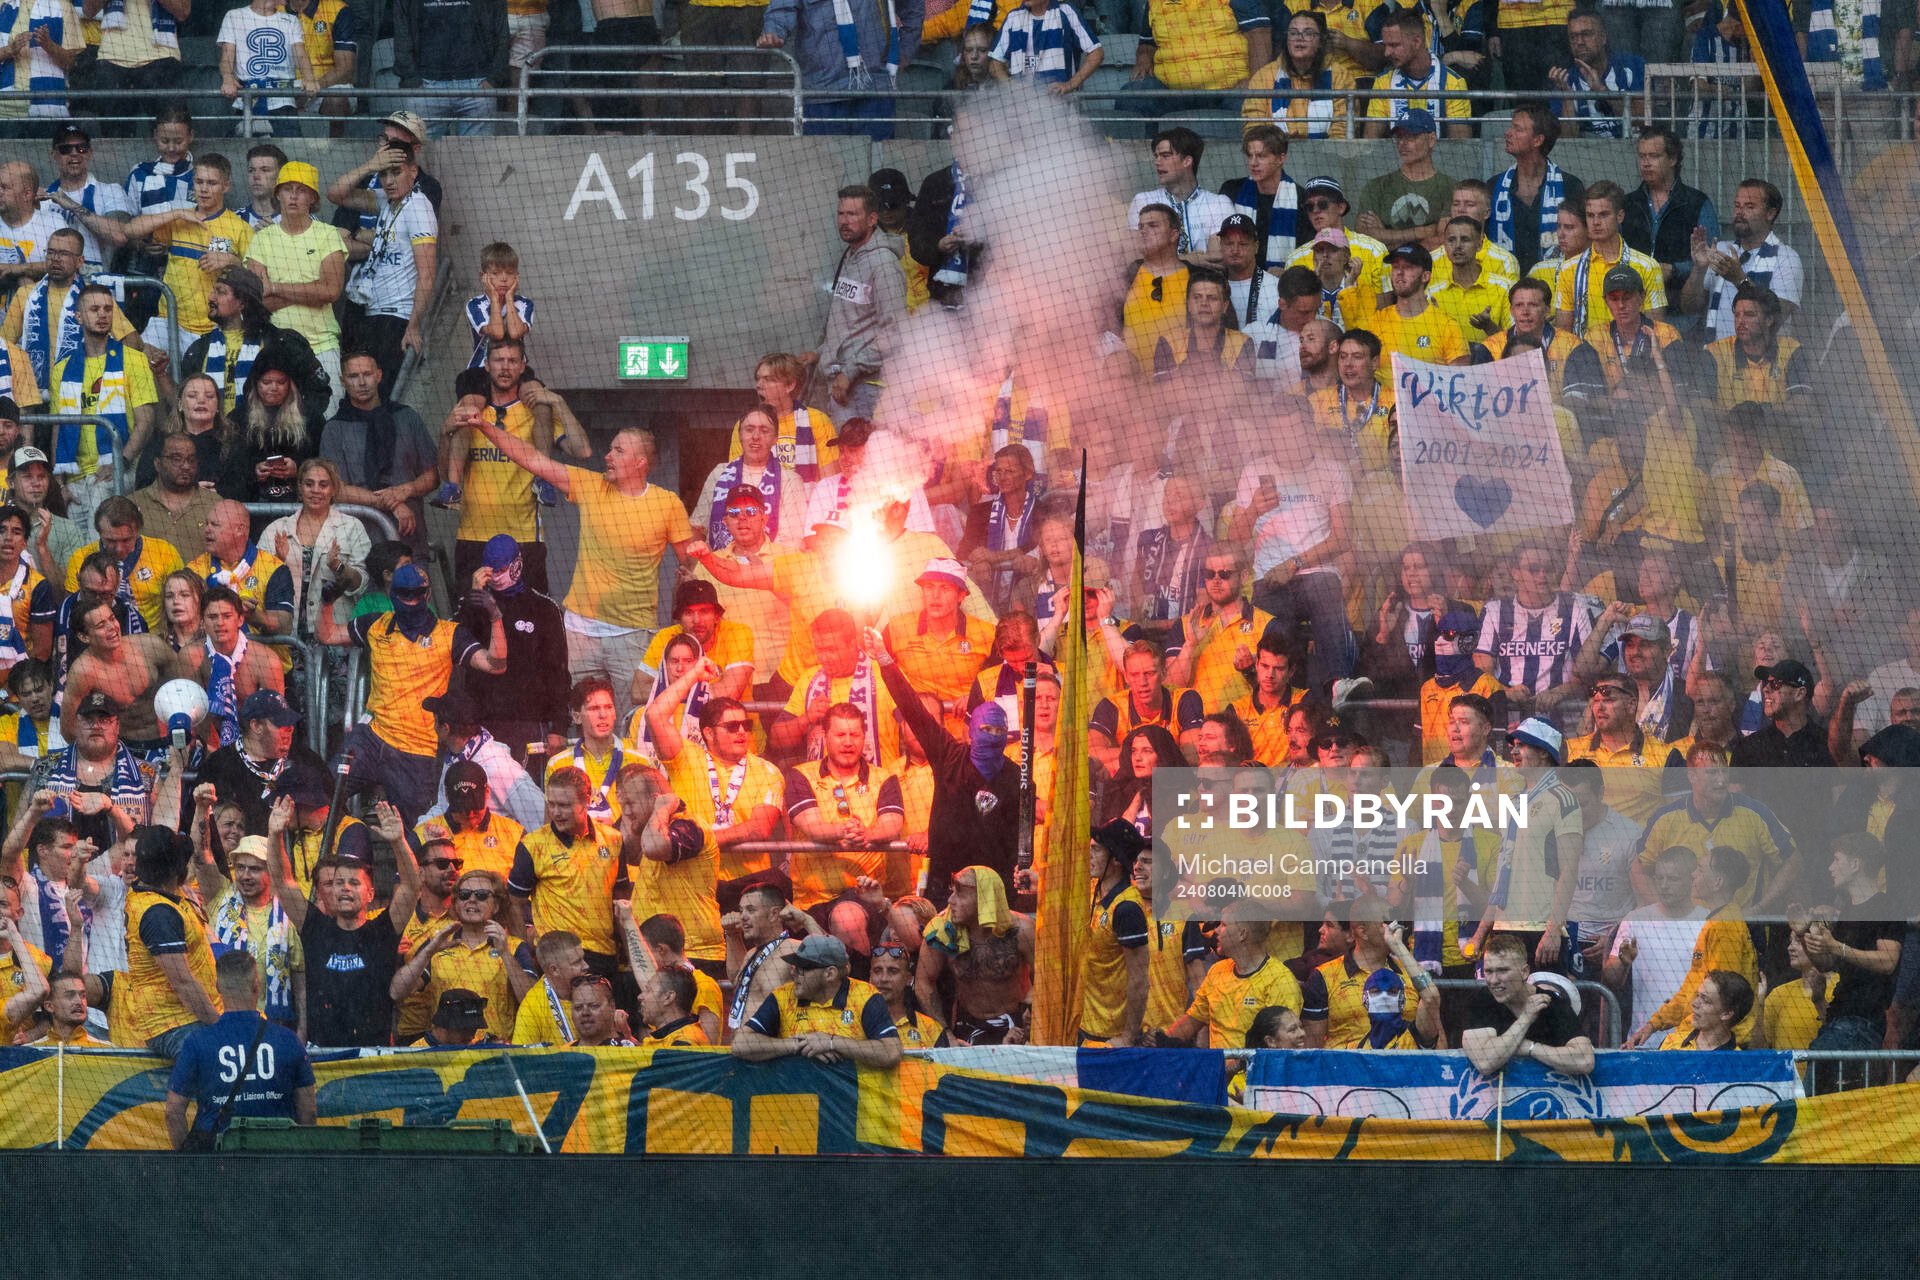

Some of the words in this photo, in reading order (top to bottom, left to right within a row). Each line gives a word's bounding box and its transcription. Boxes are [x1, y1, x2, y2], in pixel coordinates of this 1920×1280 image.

[563, 152, 760, 221] A135
[1401, 371, 1538, 432] Viktor
[1414, 440, 1548, 469] 2001-2024
[1498, 640, 1566, 657] SERNEKE
[1019, 727, 1030, 790] SHOOTER
[217, 1042, 275, 1083] SLO
